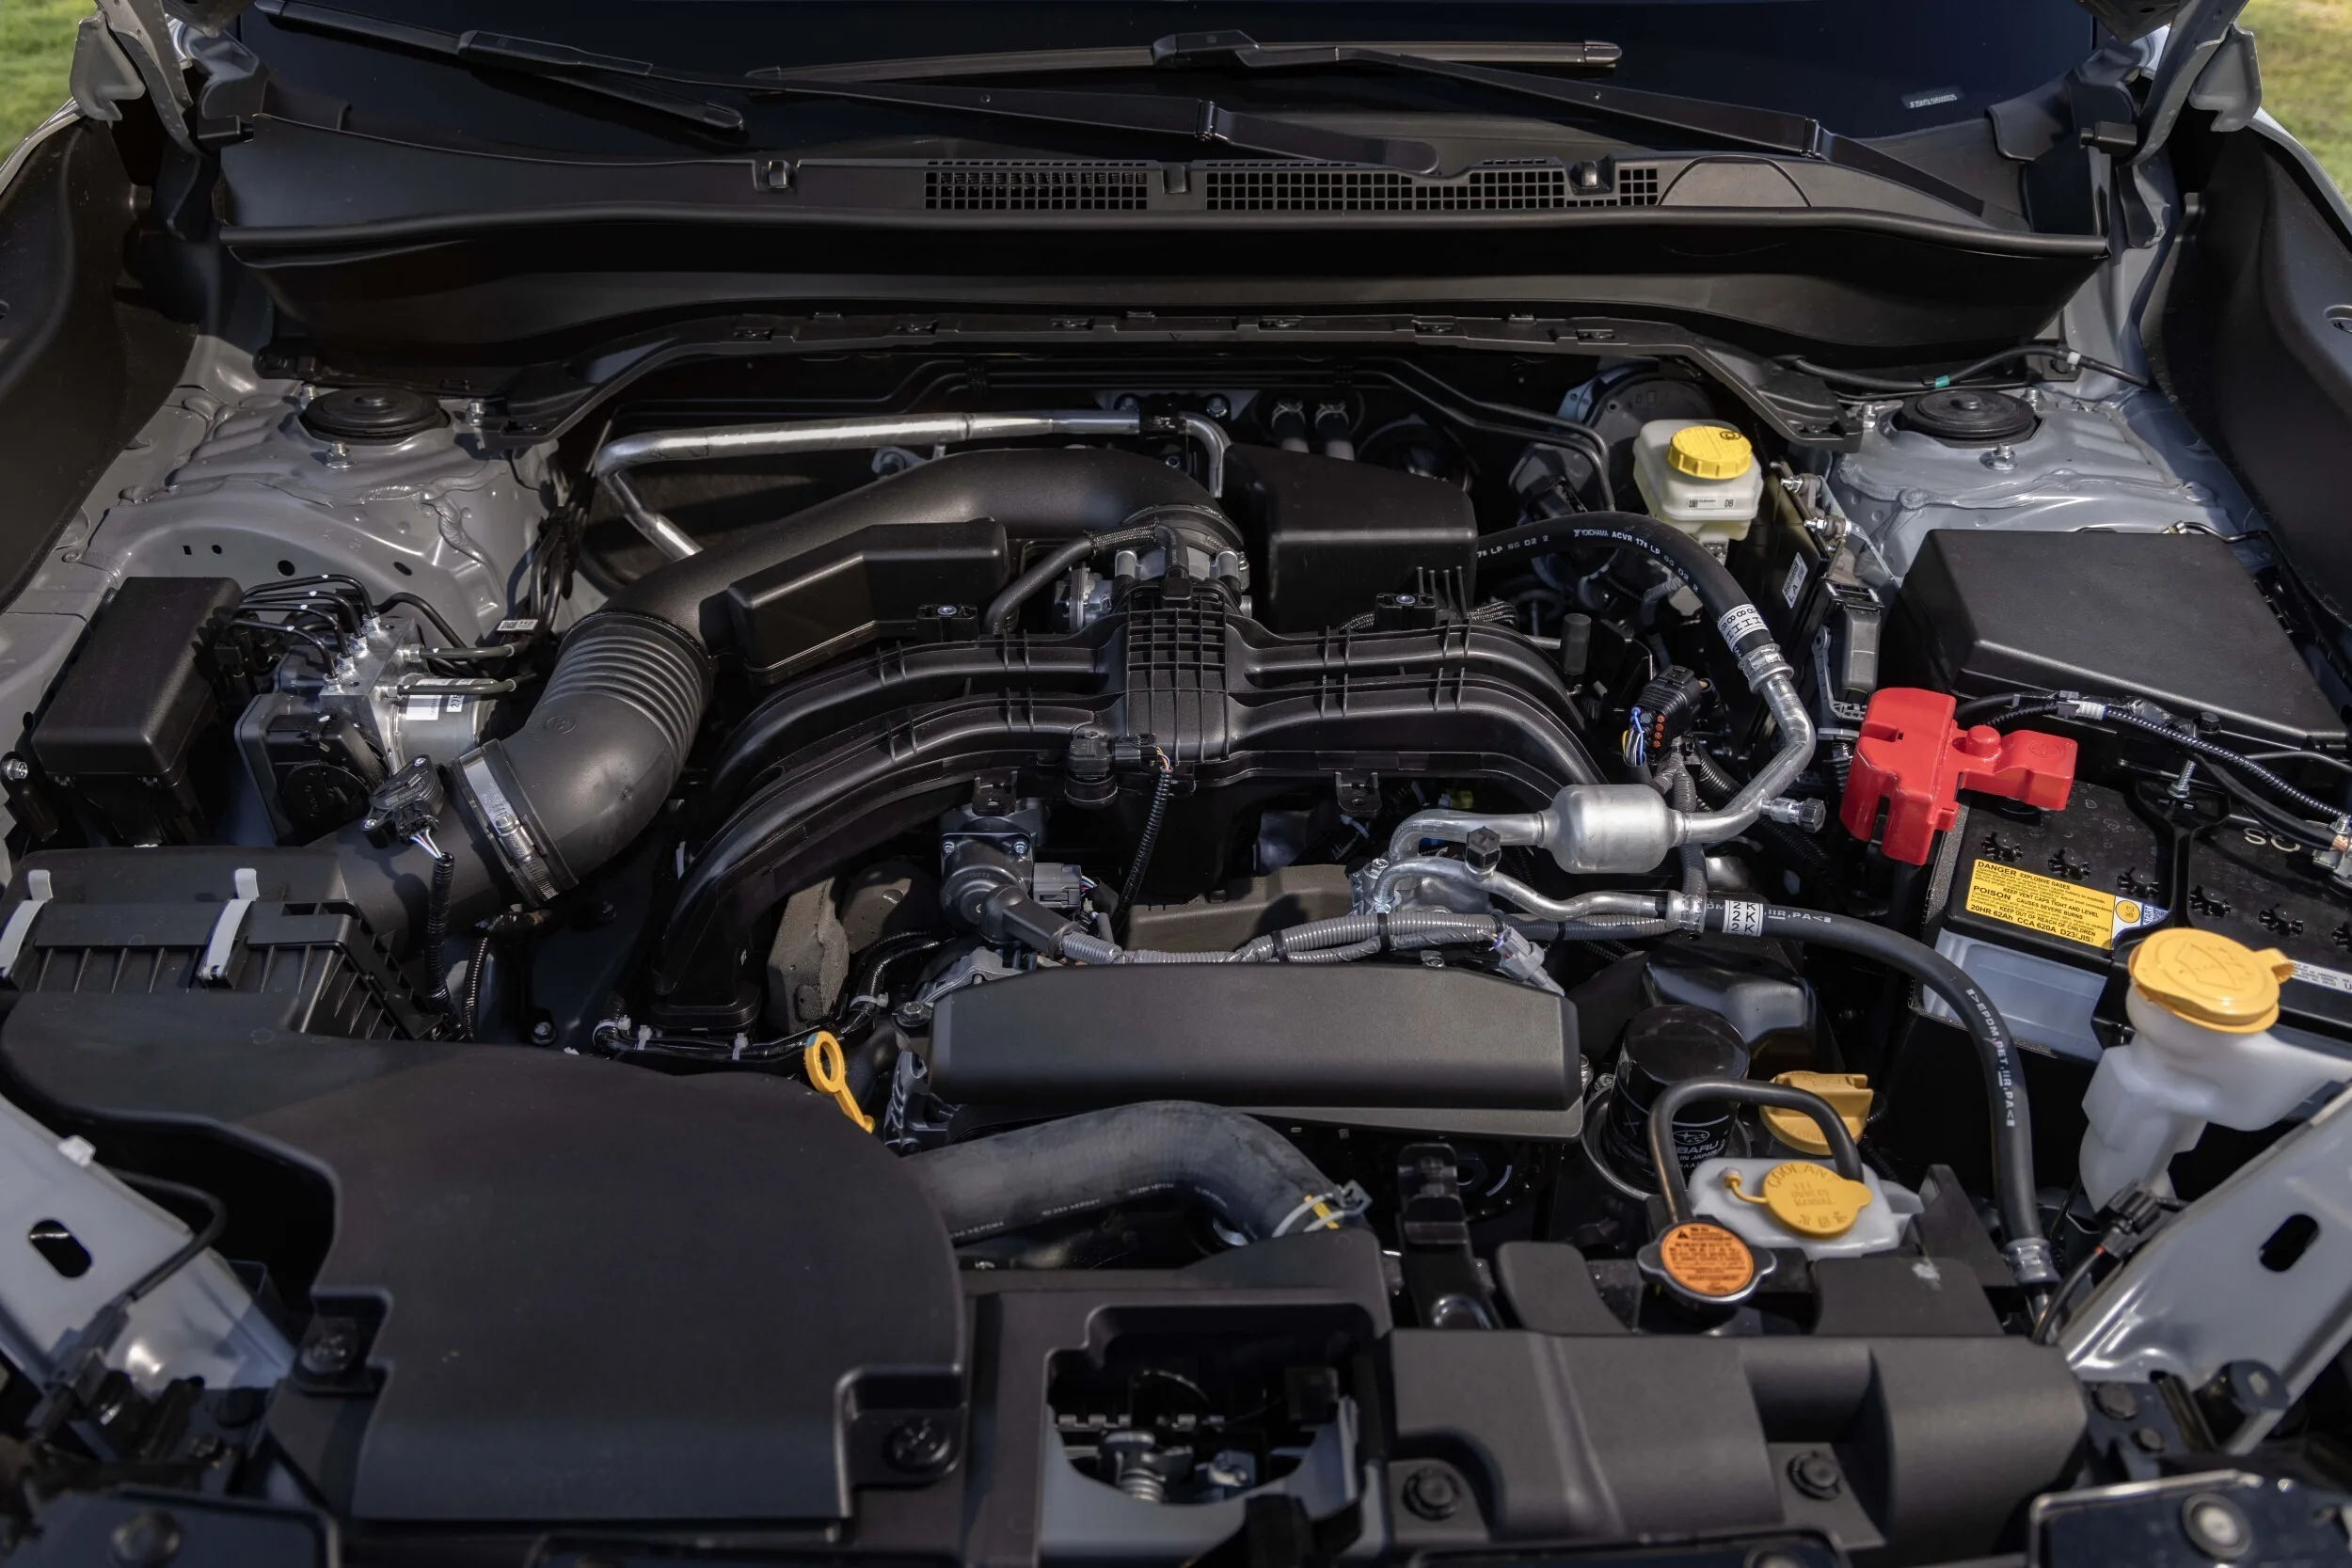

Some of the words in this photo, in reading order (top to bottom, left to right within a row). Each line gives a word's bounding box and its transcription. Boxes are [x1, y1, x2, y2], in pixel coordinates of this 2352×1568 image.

[1490, 546, 1503, 555] LP
[1612, 531, 1632, 542] ACVR
[1650, 545, 1661, 555] LP
[1978, 861, 2016, 876] DANGER
[2019, 872, 2049, 884] EXPLOSIVE
[2051, 880, 2070, 890] GASES
[1973, 885, 2010, 900] POISON
[2016, 897, 2039, 908] CAUSES
[2040, 903, 2061, 913] SEVERE
[2063, 910, 2083, 920] BURNS
[1733, 911, 1740, 921] 2
[1746, 911, 1756, 923] K
[2081, 909, 2099, 917] LEVEL
[1732, 923, 1740, 932] 2
[1745, 924, 1755, 934] K
[1970, 903, 1991, 914] 20HR
[1993, 910, 2013, 921] 62Ah
[2016, 916, 2034, 927] CCA
[2036, 922, 2056, 932] 620A
[2059, 928, 2093, 943] D23(JIS)
[2037, 915, 2057, 926] REACH
[2067, 924, 2095, 937] CHILDREN
[1677, 1140, 1720, 1153] BARU
